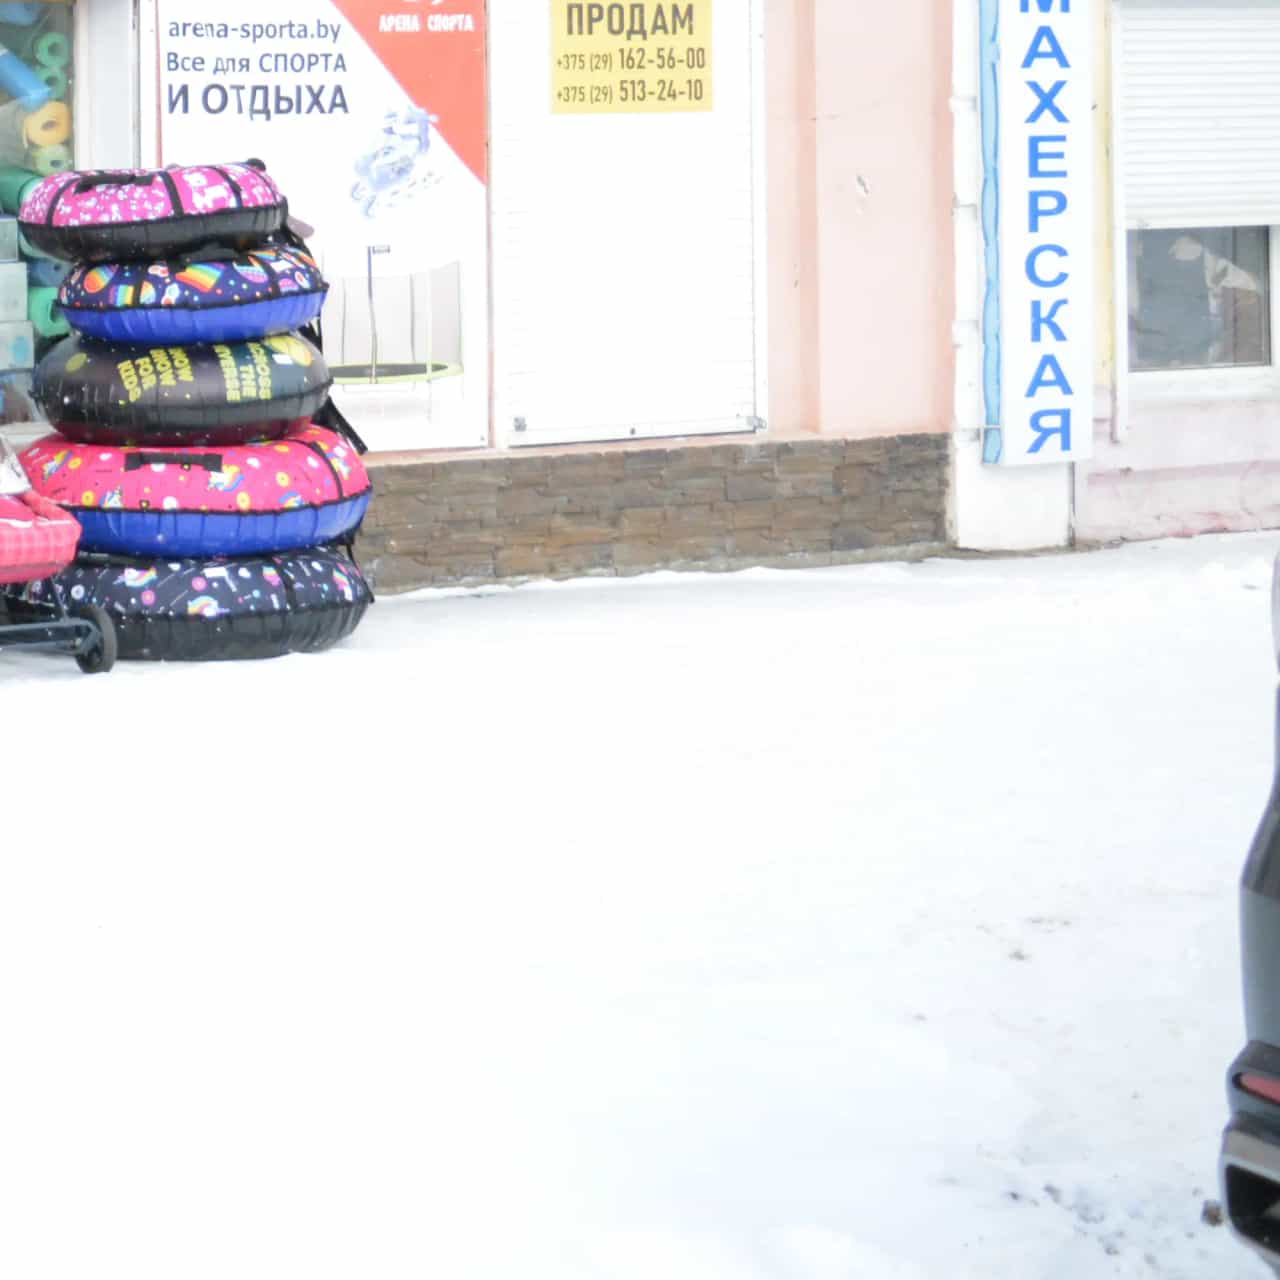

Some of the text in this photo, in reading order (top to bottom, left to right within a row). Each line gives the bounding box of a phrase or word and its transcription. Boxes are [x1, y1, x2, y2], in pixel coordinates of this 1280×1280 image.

[168, 19, 342, 44] arena-sporta.by
[566, 2, 694, 41] ПРОДАМ
[166, 13, 475, 76] Все для СПОРТА
[258, 13, 422, 73] АРЕНА СПОРТА
[556, 47, 706, 73] +375 (29) 162-56-00
[167, 83, 349, 122] И ОТДЫХА
[556, 78, 704, 105] +375 (29) 513-24-10
